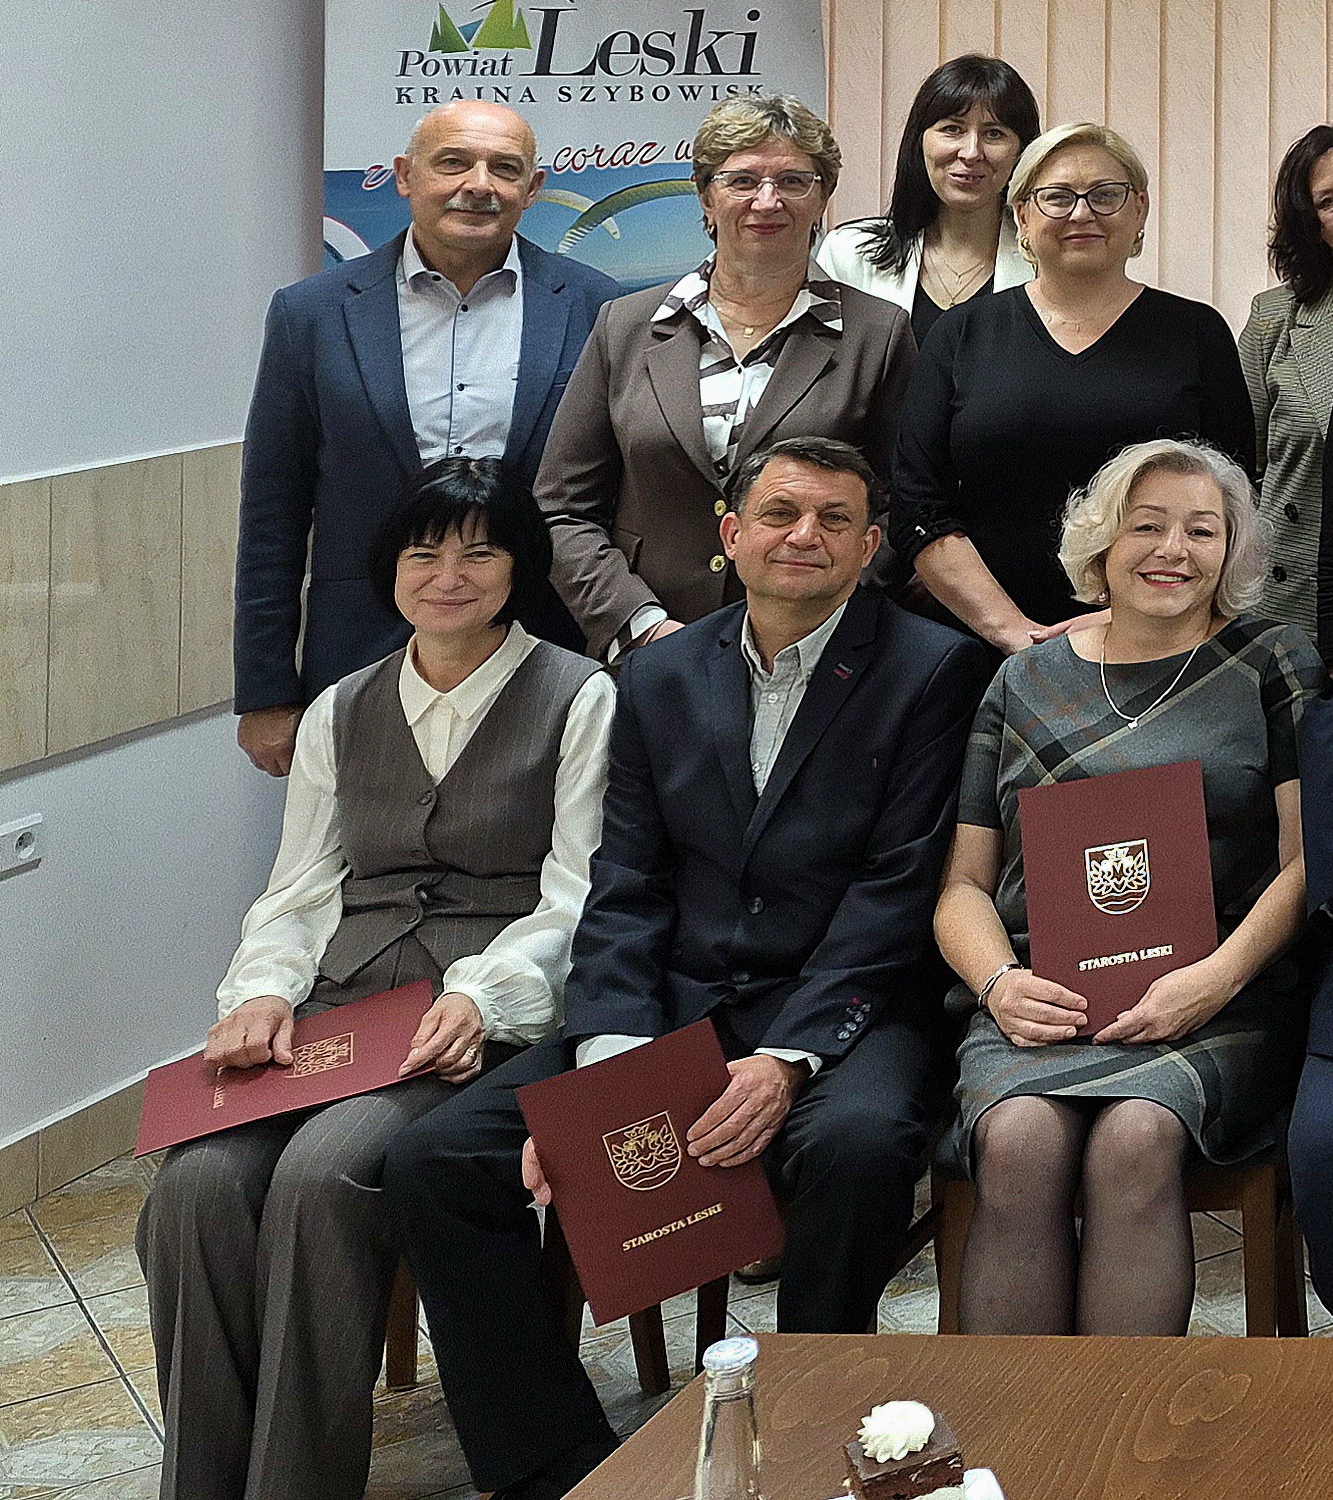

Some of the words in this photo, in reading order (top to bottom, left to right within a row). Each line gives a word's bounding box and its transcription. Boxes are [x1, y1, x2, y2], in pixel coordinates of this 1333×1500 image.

[395, 50, 513, 77] Powiat
[518, 8, 762, 77] Leski
[395, 86, 537, 105] KRAINA
[553, 141, 667, 172] coraz
[1079, 951, 1139, 972] STAROSTA
[622, 1219, 687, 1252] STAROSTA
[686, 1203, 723, 1225] LESKI
